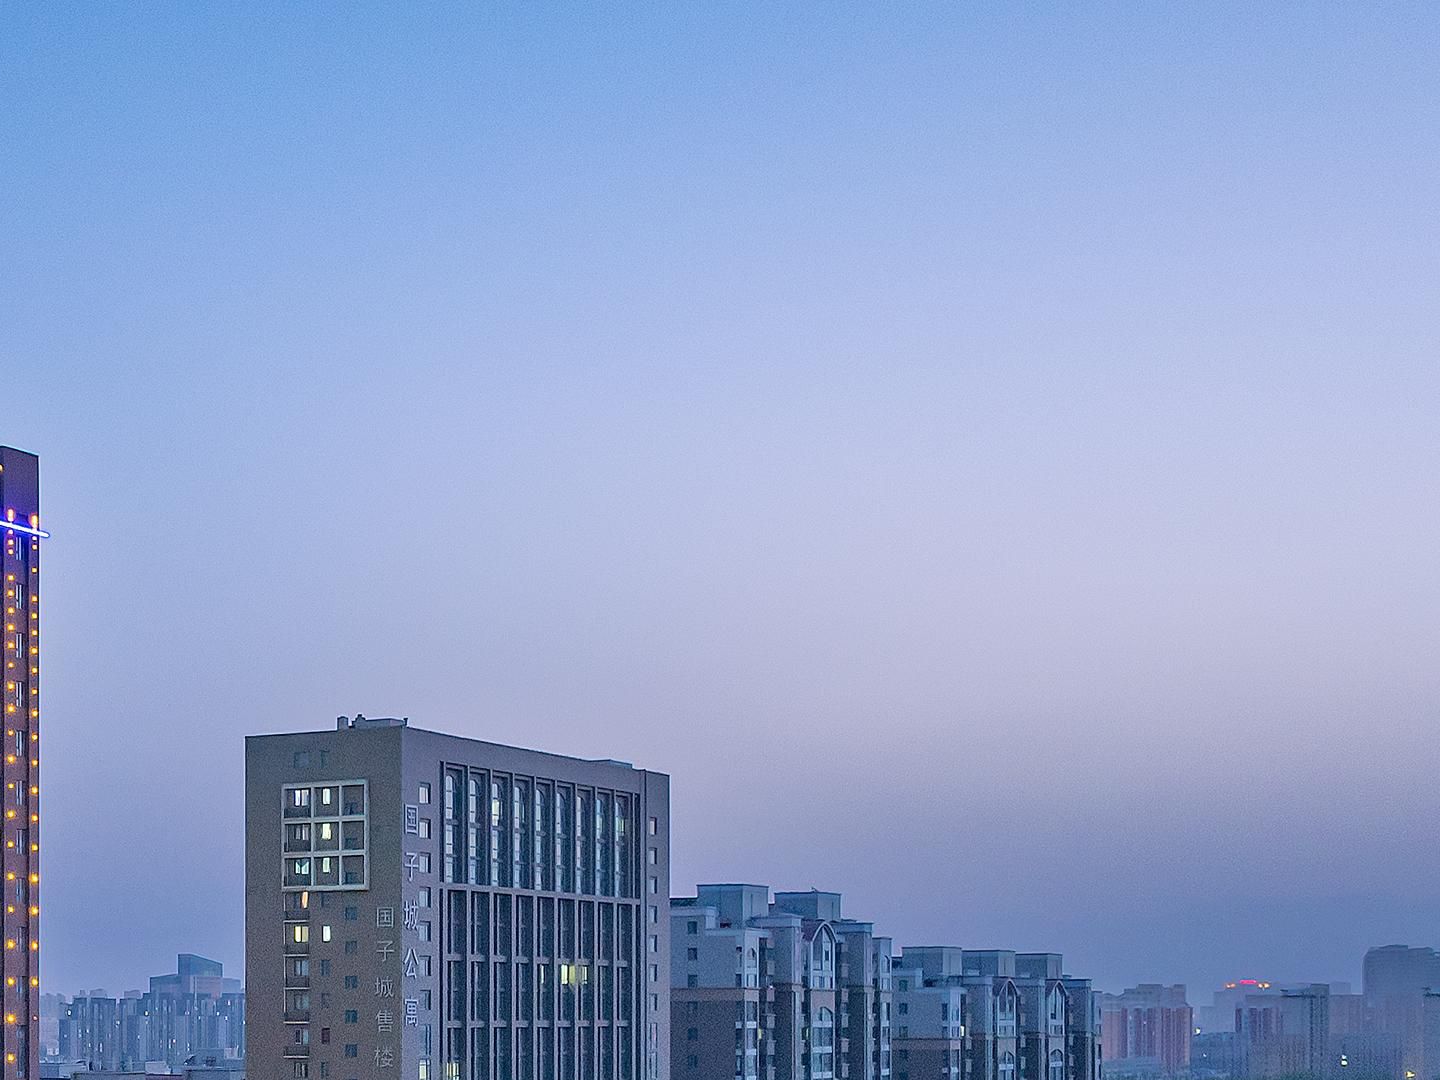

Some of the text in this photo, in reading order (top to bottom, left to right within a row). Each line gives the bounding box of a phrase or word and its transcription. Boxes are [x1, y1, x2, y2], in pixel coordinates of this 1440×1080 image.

[404, 803, 419, 1027] 国子城公寓
